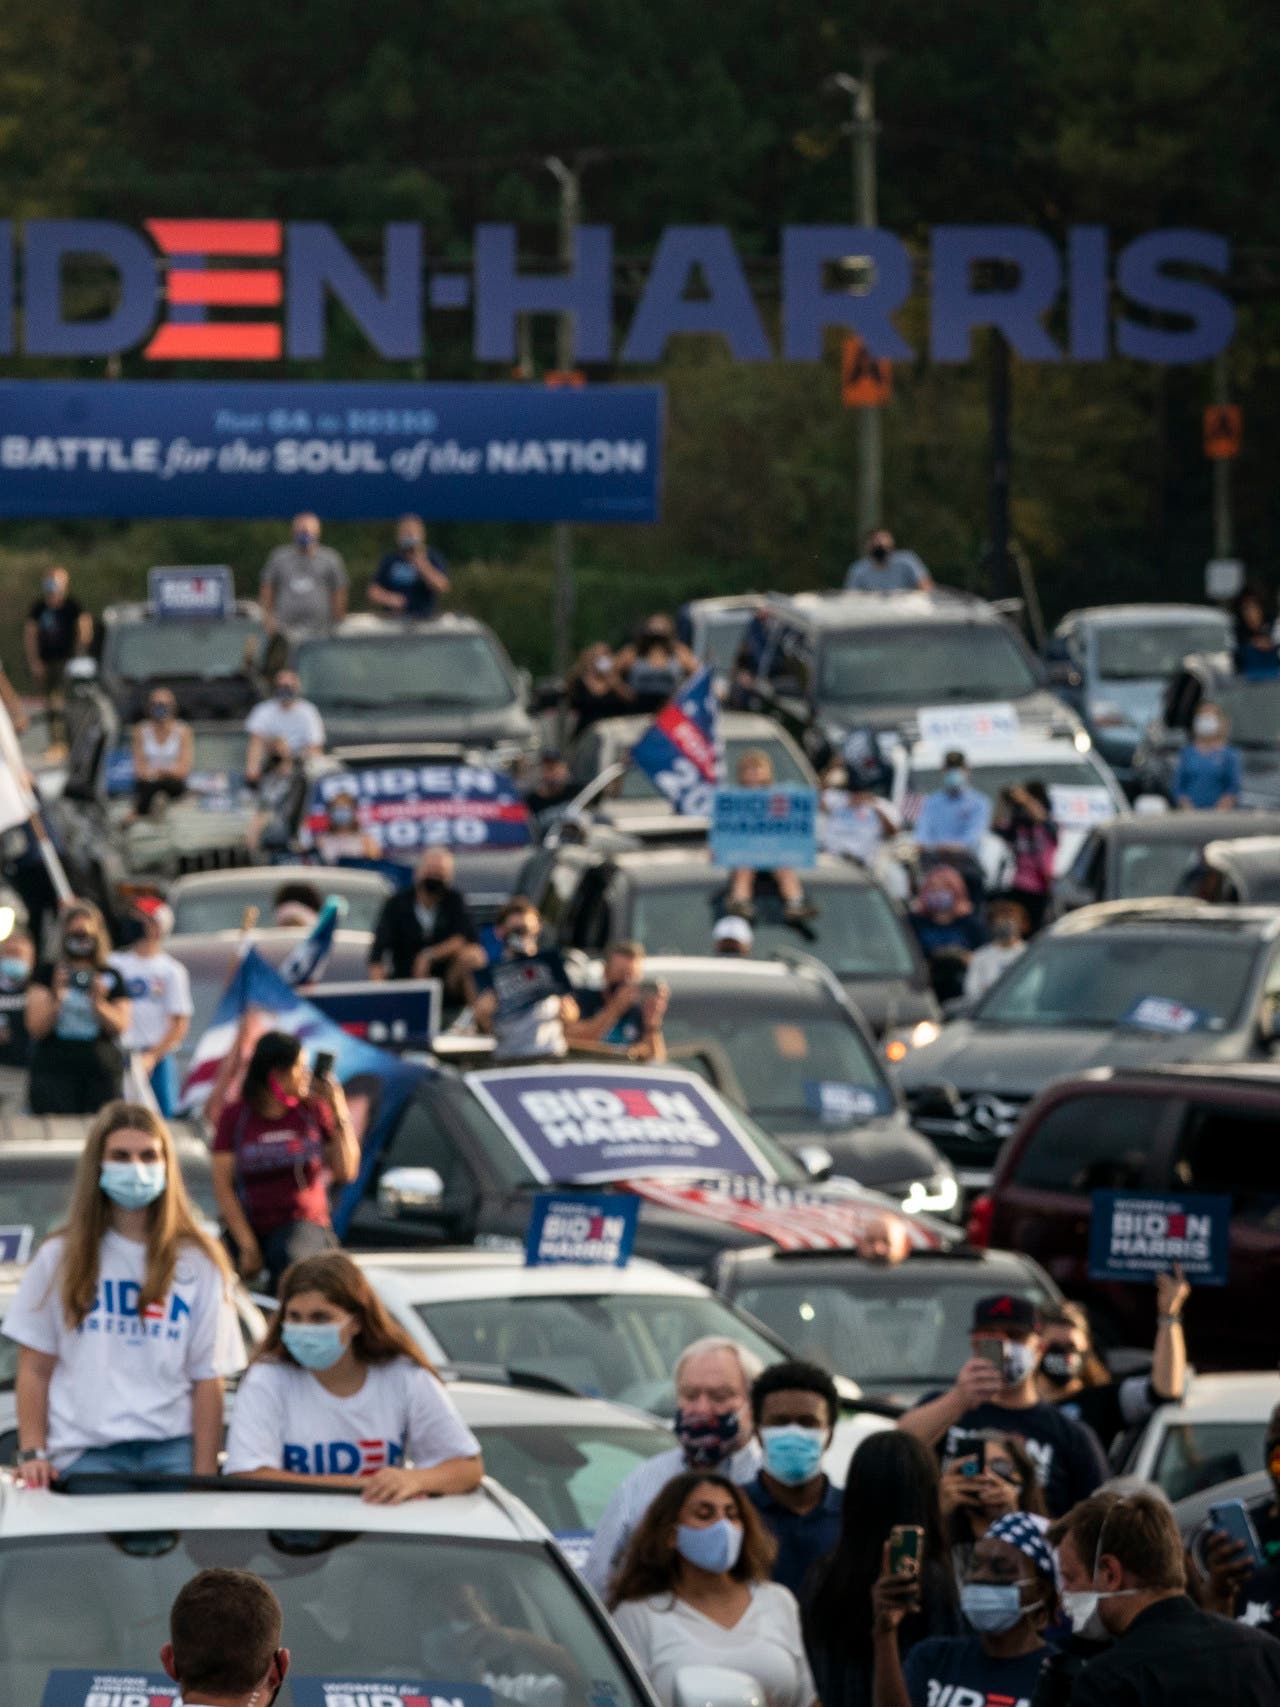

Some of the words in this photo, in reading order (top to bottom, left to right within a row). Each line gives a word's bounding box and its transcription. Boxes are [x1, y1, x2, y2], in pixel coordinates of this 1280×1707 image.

[0, 435, 161, 471] BATTLE
[158, 437, 214, 480] for
[217, 438, 268, 473] the
[272, 439, 386, 474] SOUL
[428, 440, 483, 474] the
[486, 439, 647, 474] NATION
[520, 1087, 702, 1124] BIDEN
[1111, 1212, 1211, 1238] BIDEN
[1110, 1237, 1210, 1260] HARRIS
[89, 1279, 191, 1322] IDEN
